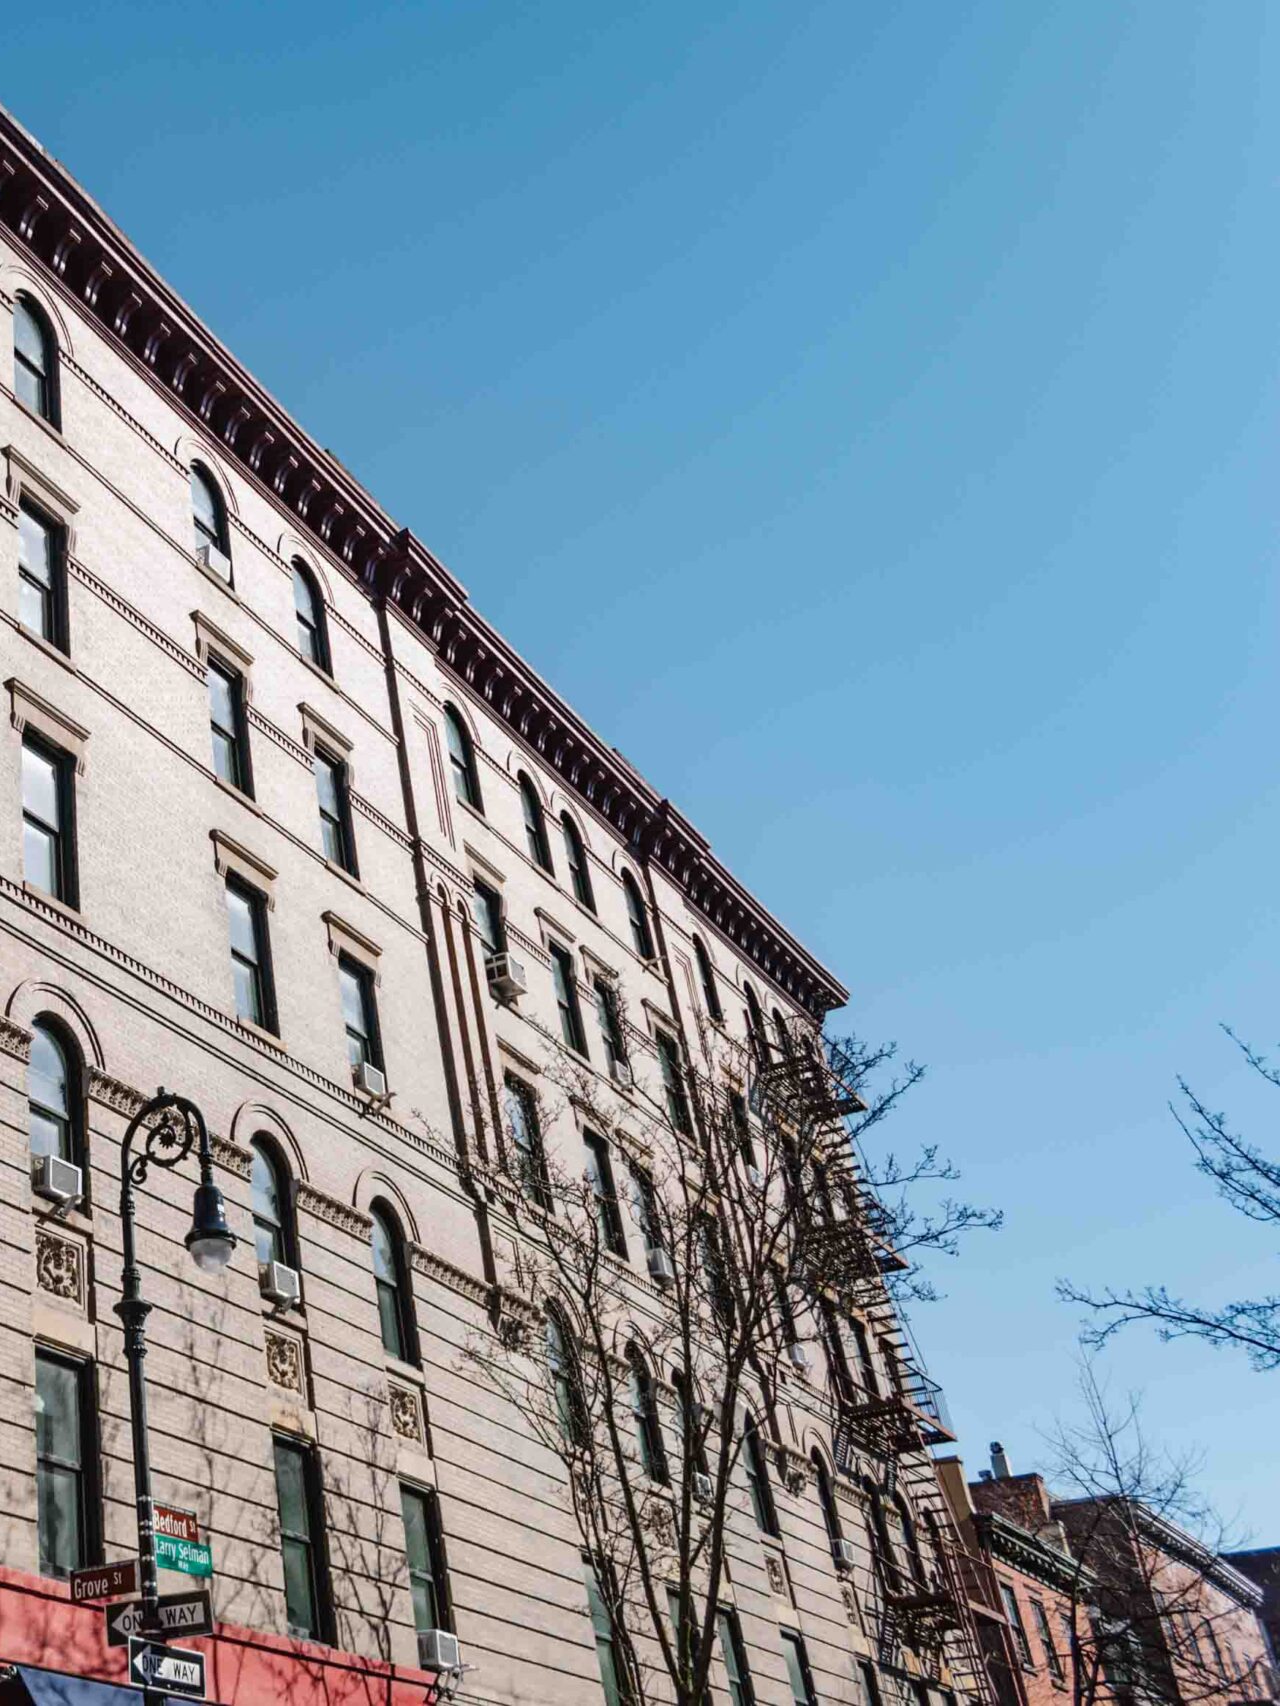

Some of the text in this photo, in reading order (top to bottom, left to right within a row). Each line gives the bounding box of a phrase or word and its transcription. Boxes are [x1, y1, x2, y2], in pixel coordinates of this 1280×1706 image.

[153, 1510, 196, 1538] Bedford St
[154, 1536, 209, 1564] Larry Selman
[74, 1571, 122, 1599] Grove St
[122, 1605, 197, 1631] ON WAY
[142, 1655, 195, 1681] ONE WAY
